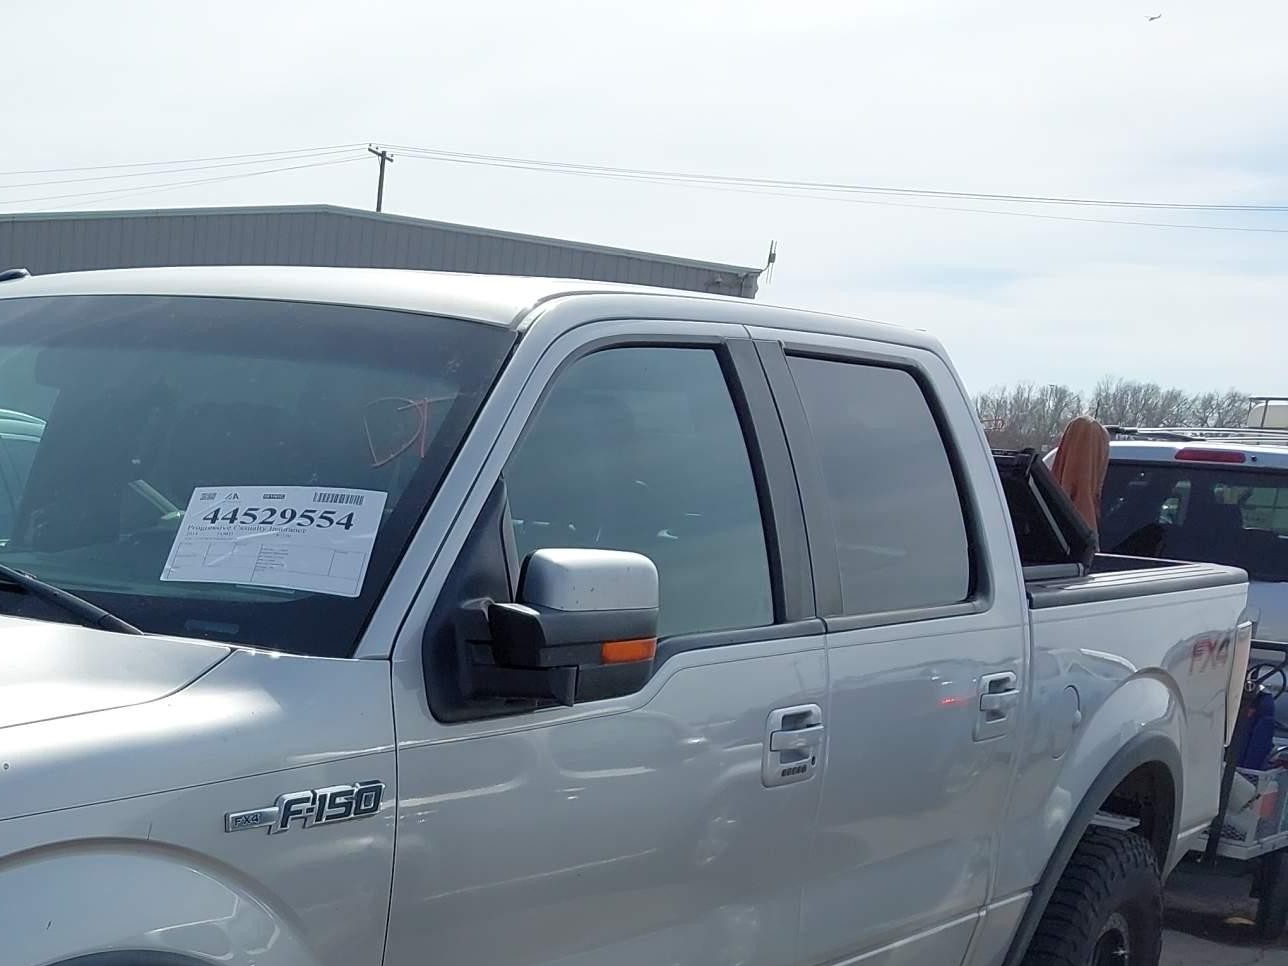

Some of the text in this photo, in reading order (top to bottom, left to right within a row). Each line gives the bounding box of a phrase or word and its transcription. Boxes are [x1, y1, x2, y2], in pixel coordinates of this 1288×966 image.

[203, 507, 355, 530] 44529554
[234, 780, 386, 834] FX4 F-150
